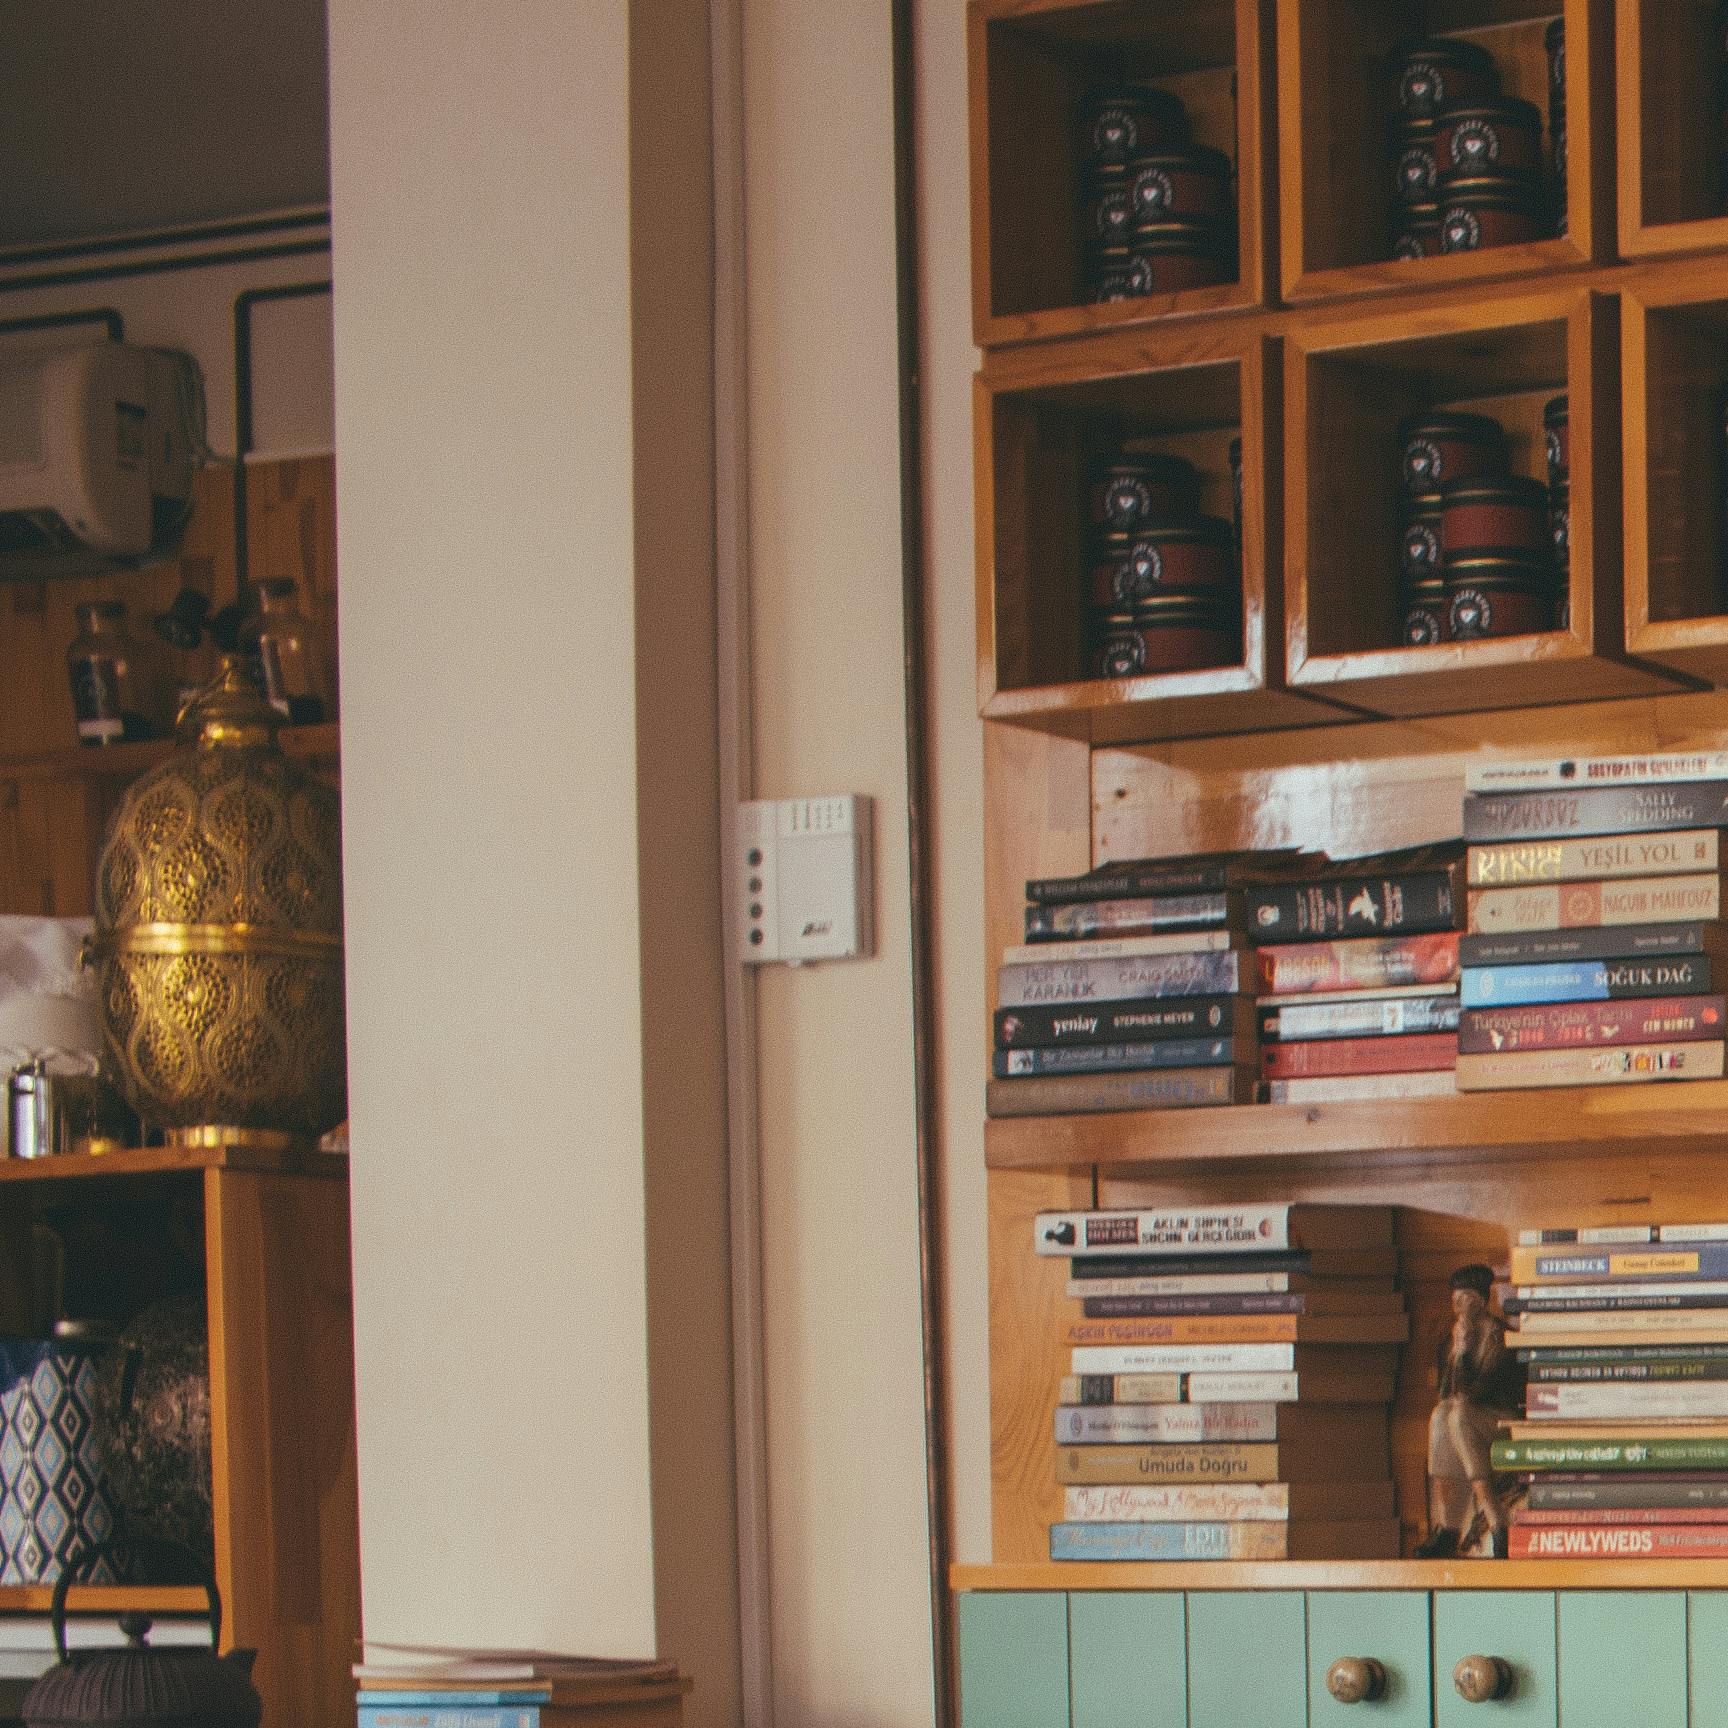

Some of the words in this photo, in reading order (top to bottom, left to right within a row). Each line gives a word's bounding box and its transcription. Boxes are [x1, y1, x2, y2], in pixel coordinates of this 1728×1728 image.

[1580, 846, 1634, 870] YEŞİL
[1639, 844, 1681, 864] YOL
[1593, 966, 1652, 988] SOĞUK
[1656, 963, 1693, 984] DAĞ
[1139, 1456, 1195, 1473] Umuda
[1199, 1456, 1250, 1476] Doğru
[1540, 1531, 1653, 1552] NEWLYWEDS
